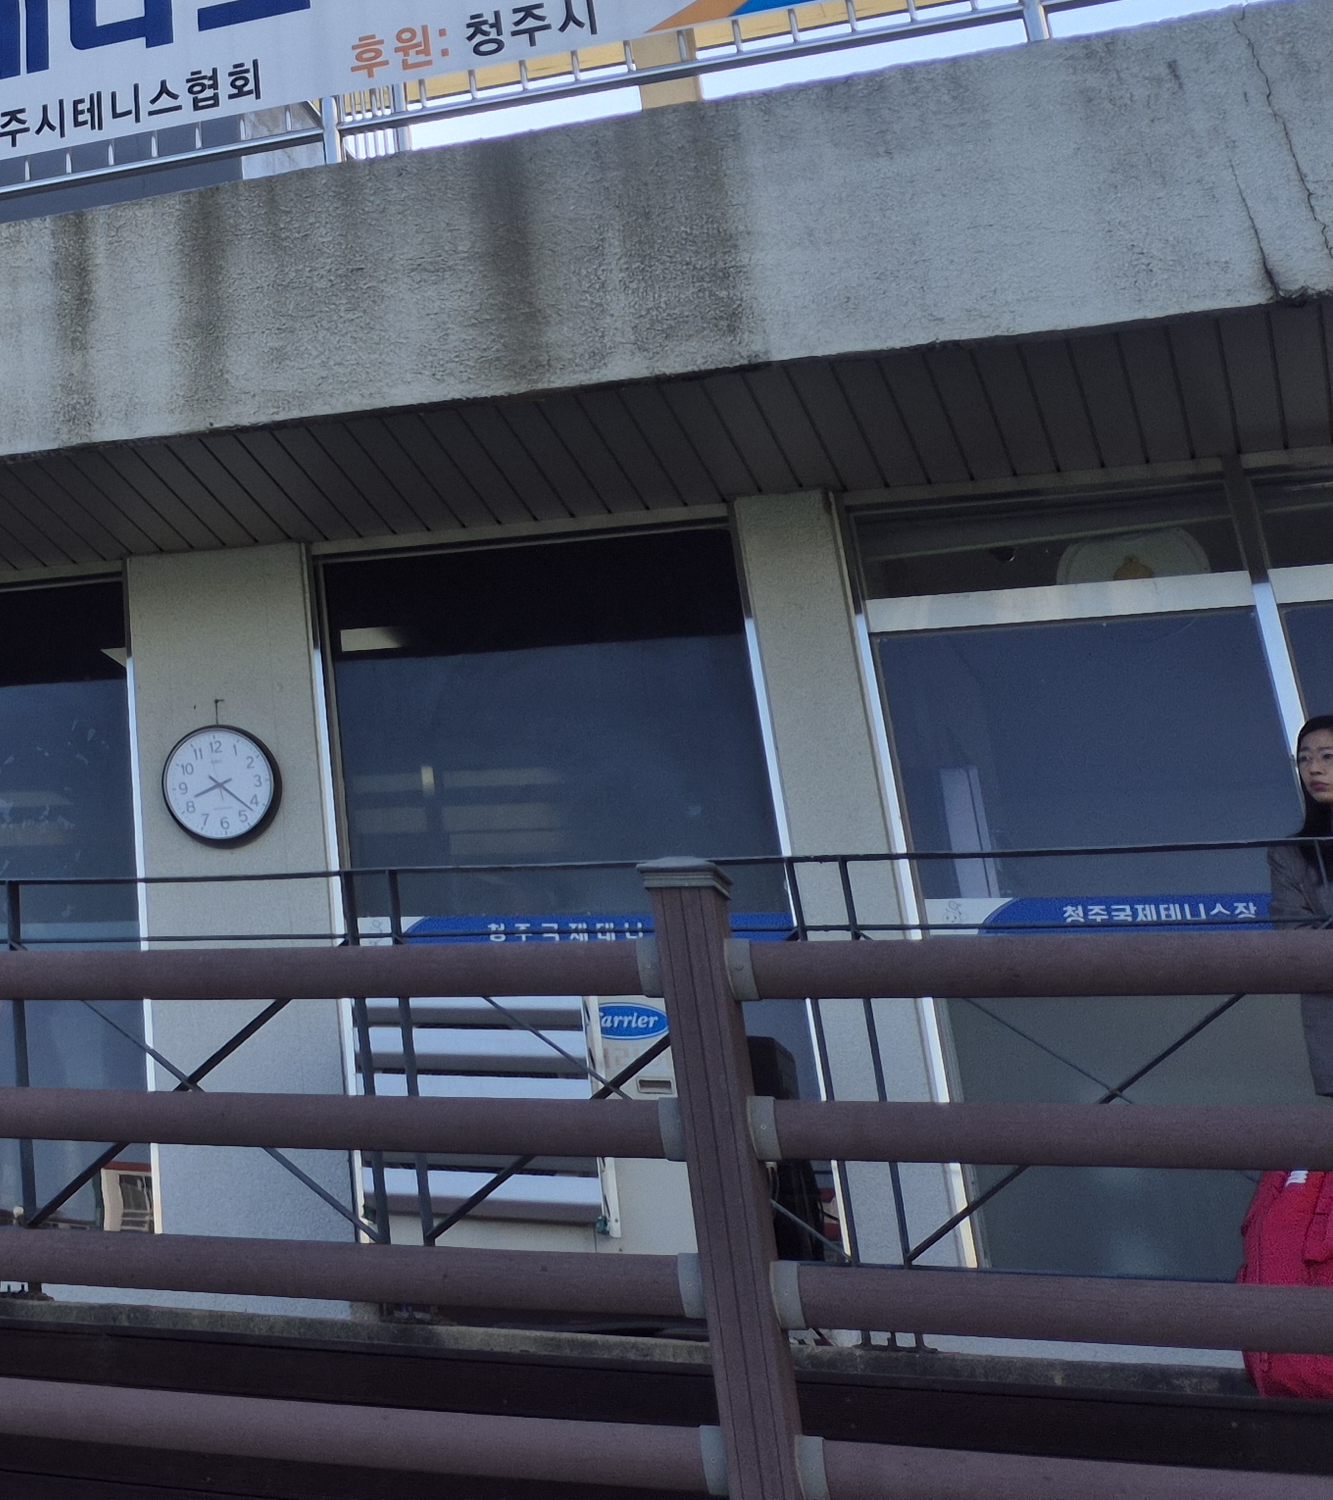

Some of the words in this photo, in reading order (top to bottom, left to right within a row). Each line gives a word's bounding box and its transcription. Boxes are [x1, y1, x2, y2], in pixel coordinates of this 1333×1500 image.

[348, 23, 450, 80] 후원:
[193, 747, 204, 761] 11
[209, 740, 223, 754] 12
[233, 743, 238, 757] 1
[180, 762, 195, 776] 10
[246, 755, 255, 770] 2
[253, 774, 263, 788] 3
[178, 781, 189, 796] 9
[185, 800, 196, 814] 8
[249, 793, 260, 807] 4
[200, 813, 210, 827] 7
[238, 809, 249, 823] 5
[219, 816, 231, 831] 6
[1062, 900, 1259, 925] 청주국제테니스장
[487, 921, 645, 943] 청주국제테니
[598, 1012, 659, 1029] arrier
